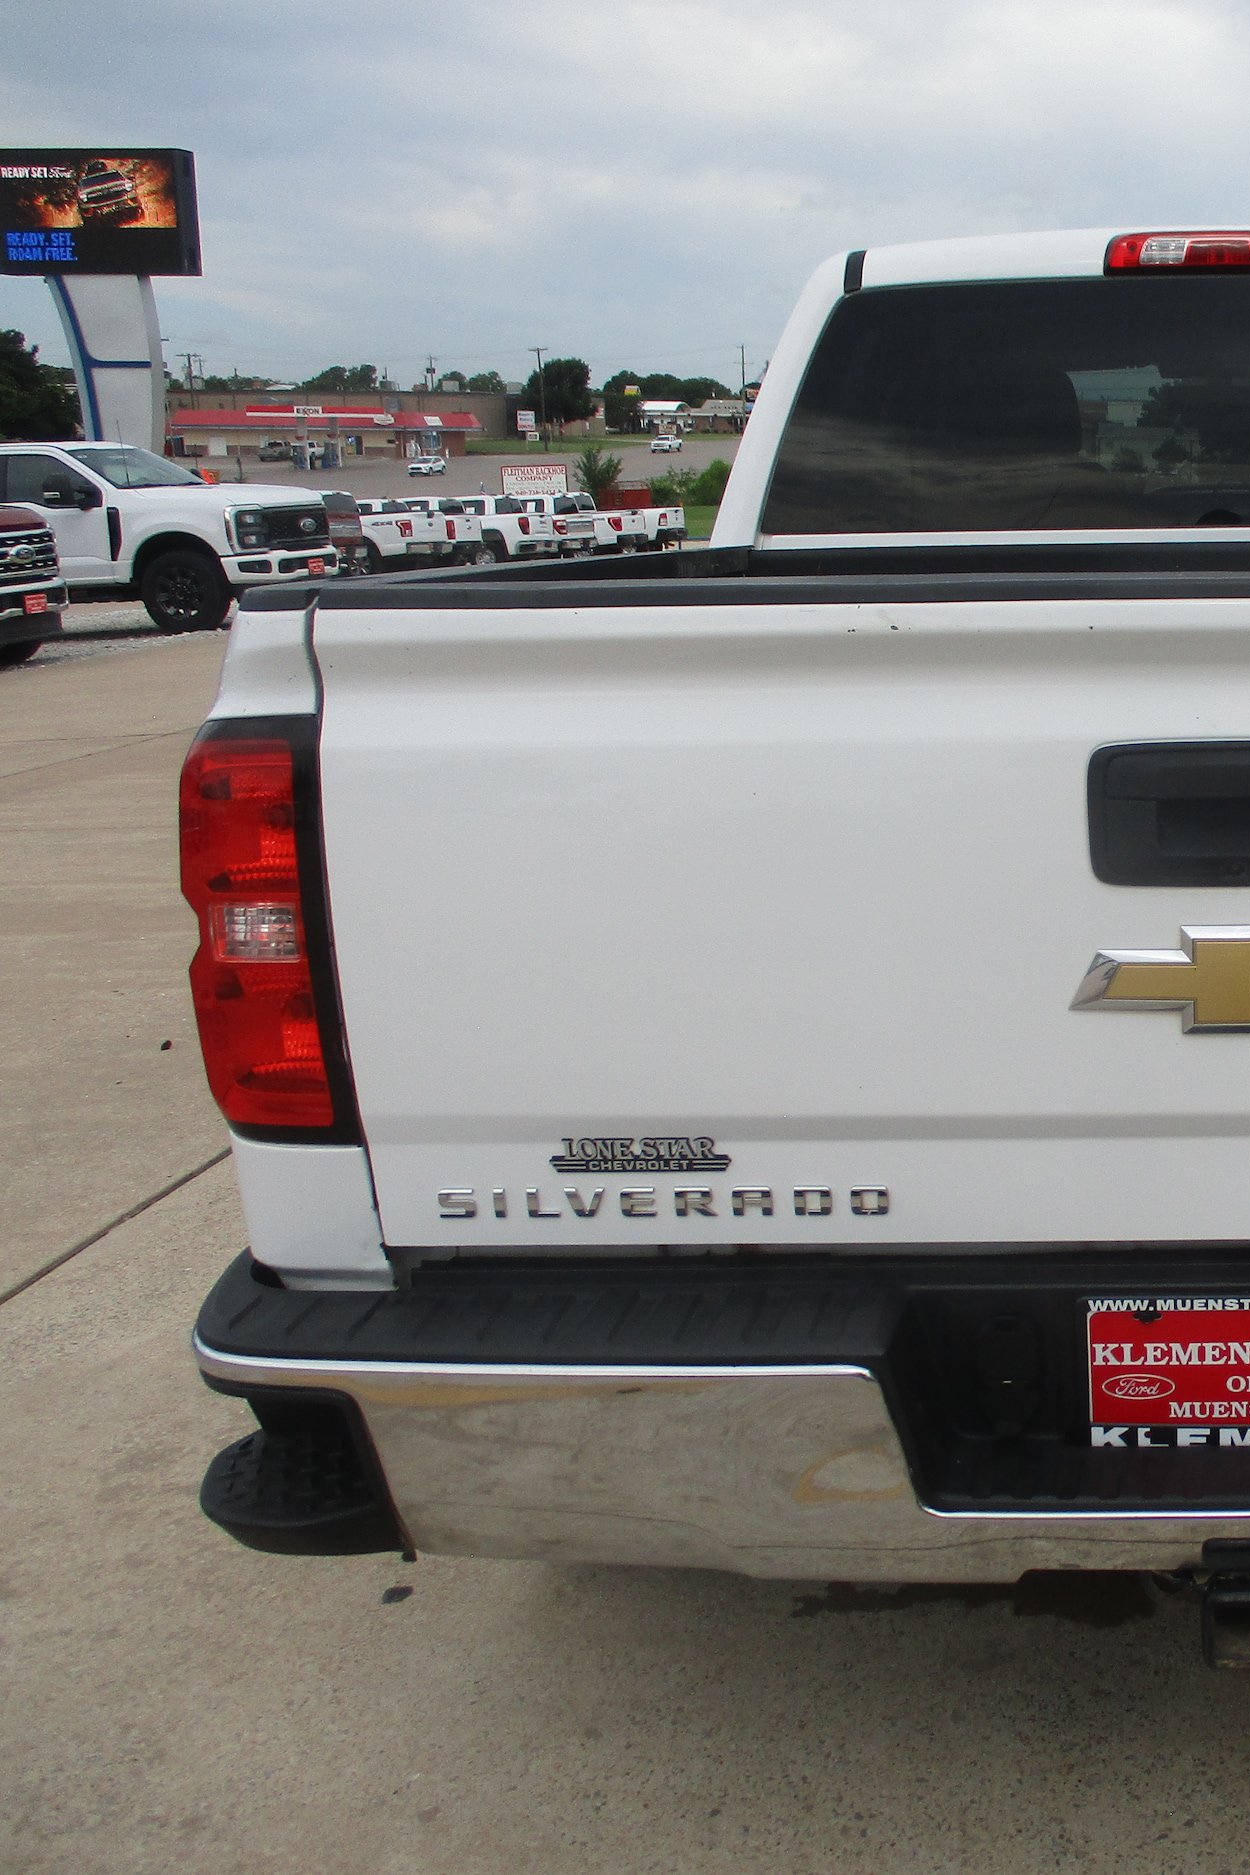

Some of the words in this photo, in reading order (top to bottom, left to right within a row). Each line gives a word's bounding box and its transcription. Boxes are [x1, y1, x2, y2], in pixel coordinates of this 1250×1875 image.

[0, 166, 29, 178] READY
[30, 166, 47, 178] SET
[562, 1138, 634, 1160] LONE
[639, 1137, 716, 1160] STAR
[588, 1160, 689, 1171] CHEVROLET
[437, 1184, 890, 1218] SILVERADO
[1114, 1378, 1161, 1397] Ford
